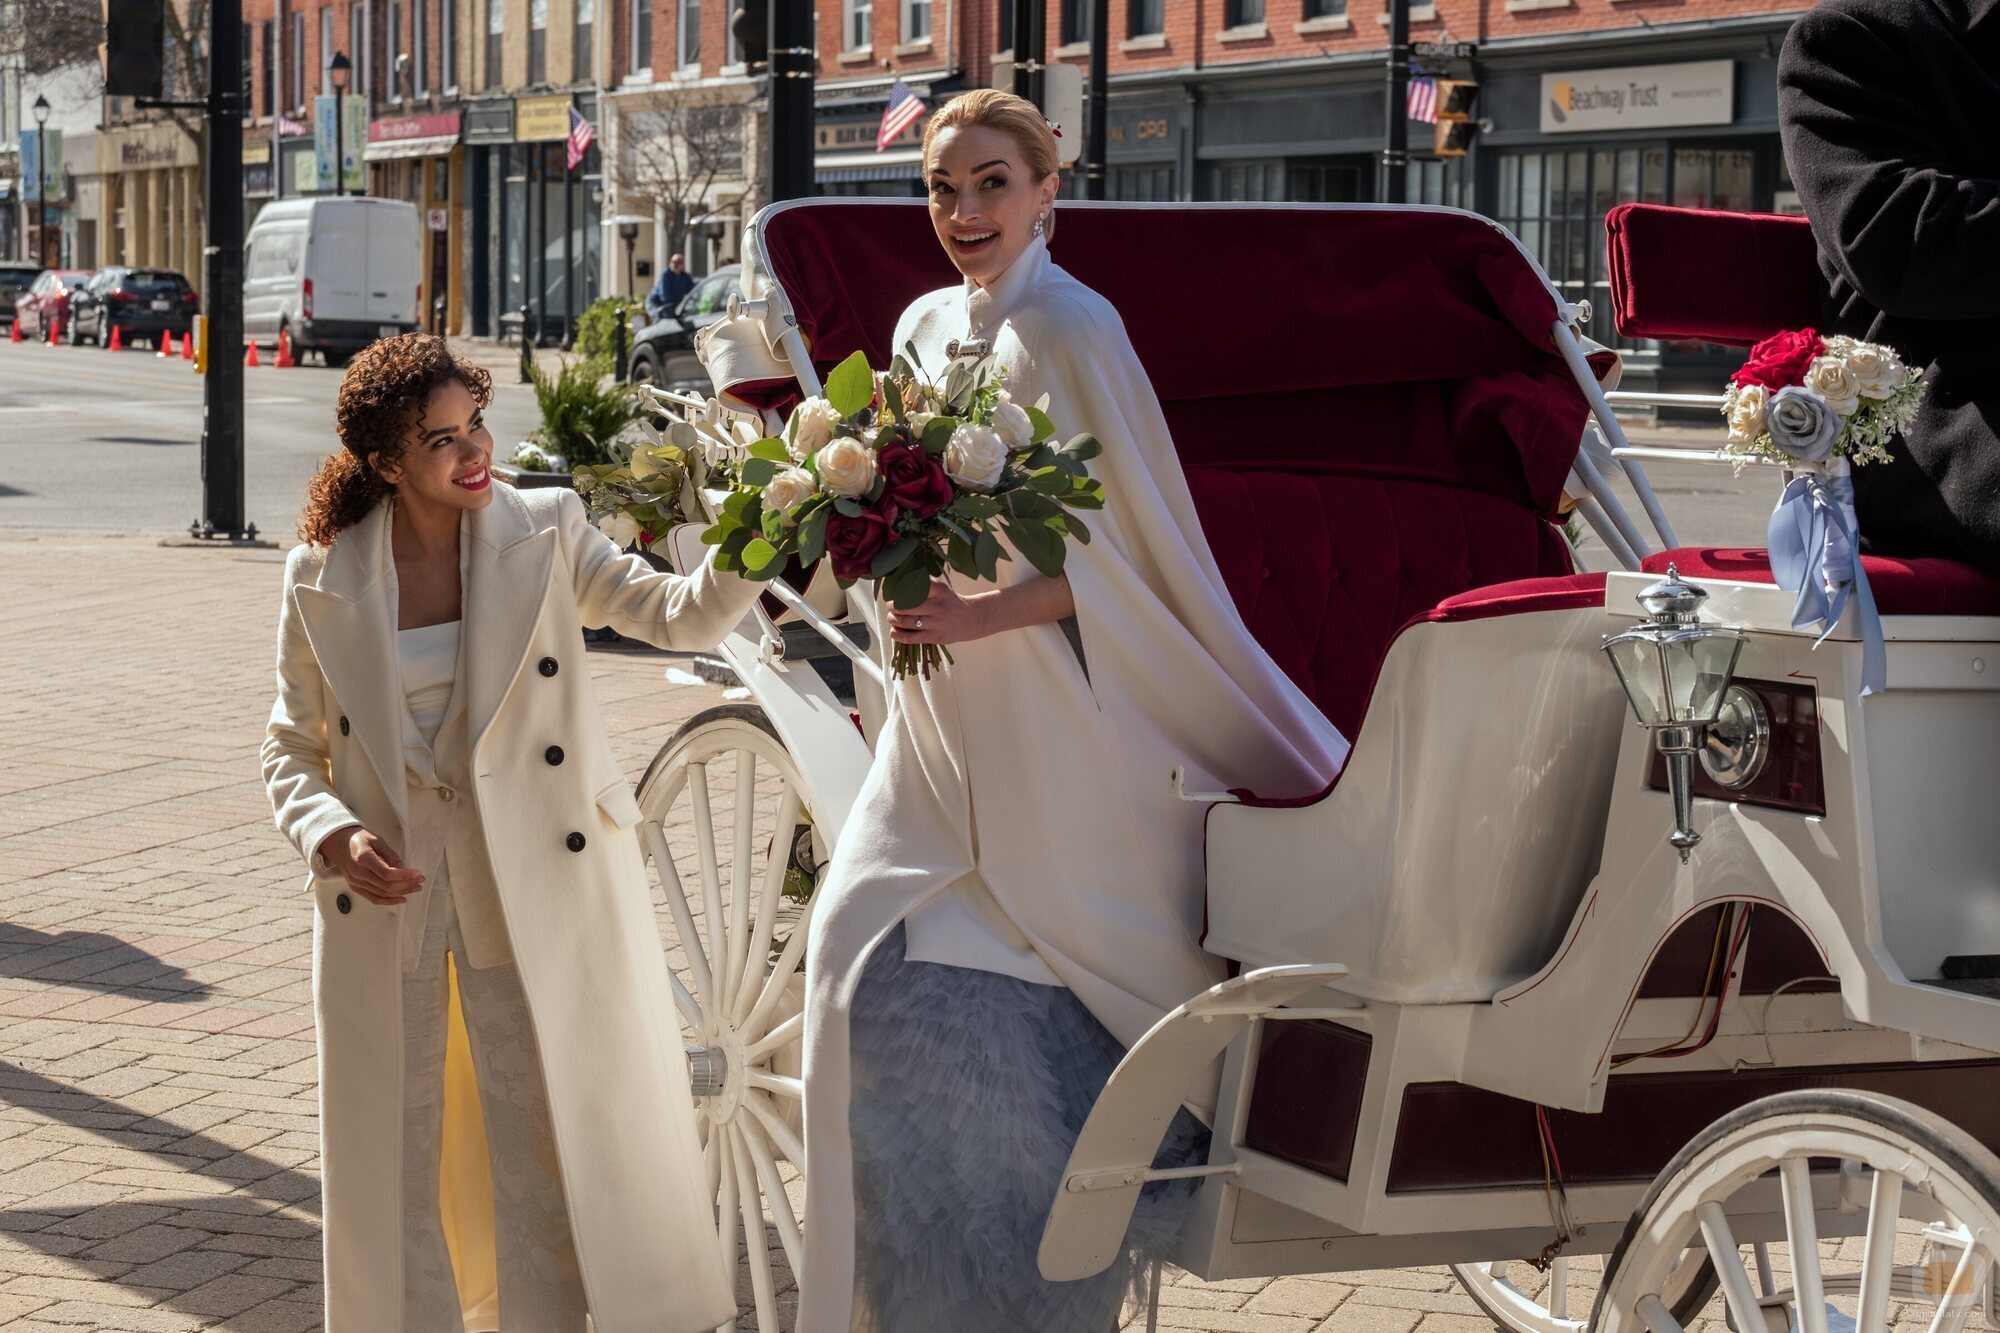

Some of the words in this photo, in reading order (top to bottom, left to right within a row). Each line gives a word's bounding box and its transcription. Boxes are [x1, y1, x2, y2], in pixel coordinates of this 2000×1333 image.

[1414, 43, 1456, 57] GEORGE
[1569, 83, 1625, 115] Beachway
[1629, 82, 1659, 107] Trust
